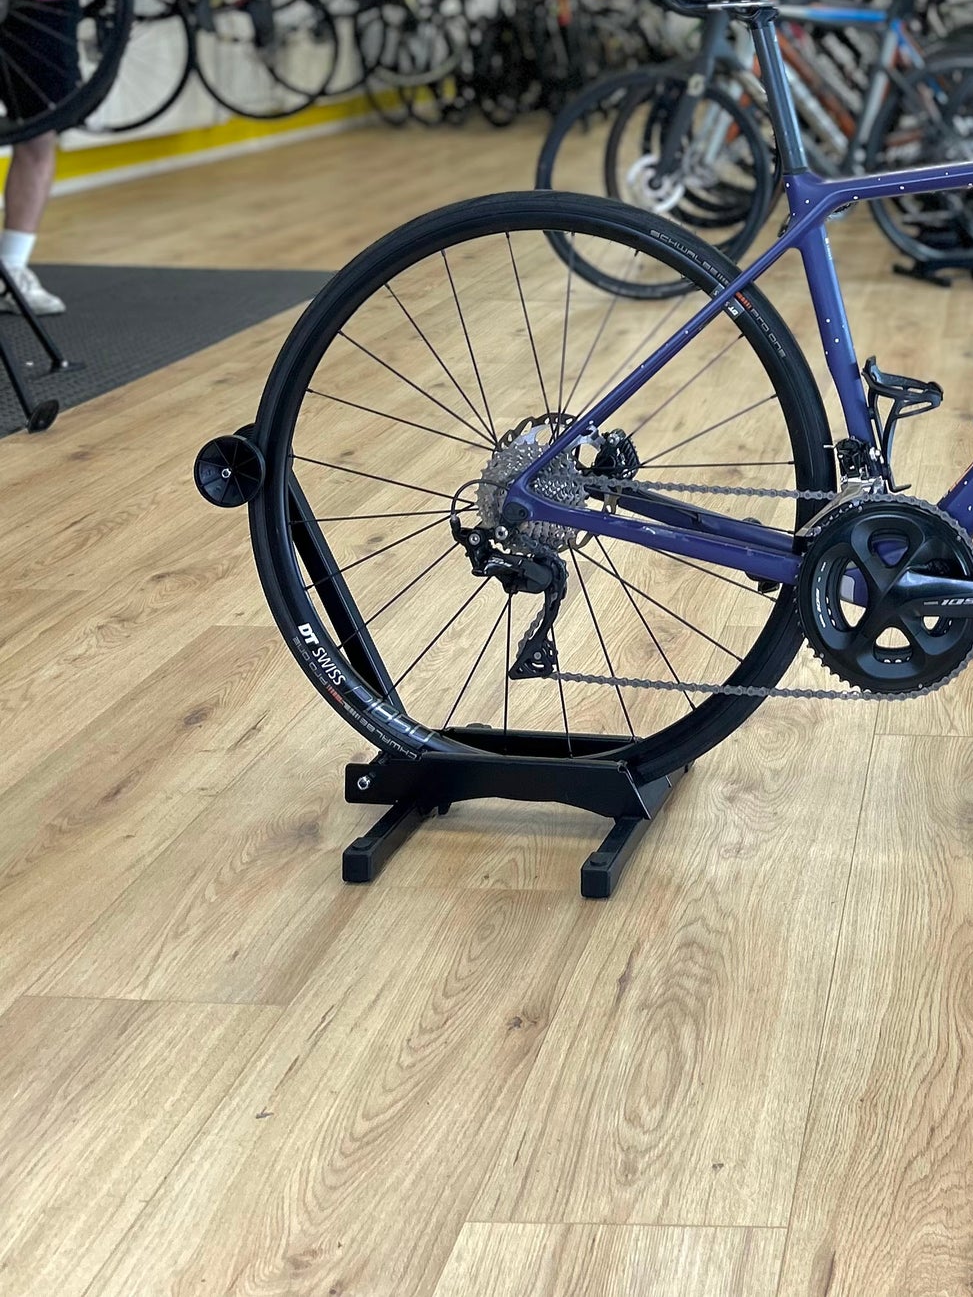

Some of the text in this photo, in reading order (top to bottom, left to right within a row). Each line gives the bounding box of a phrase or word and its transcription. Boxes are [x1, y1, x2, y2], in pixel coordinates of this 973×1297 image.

[650, 230, 718, 276] SCHWALBE
[298, 623, 347, 686] DT SWISS
[359, 716, 419, 761] CHWALBE
